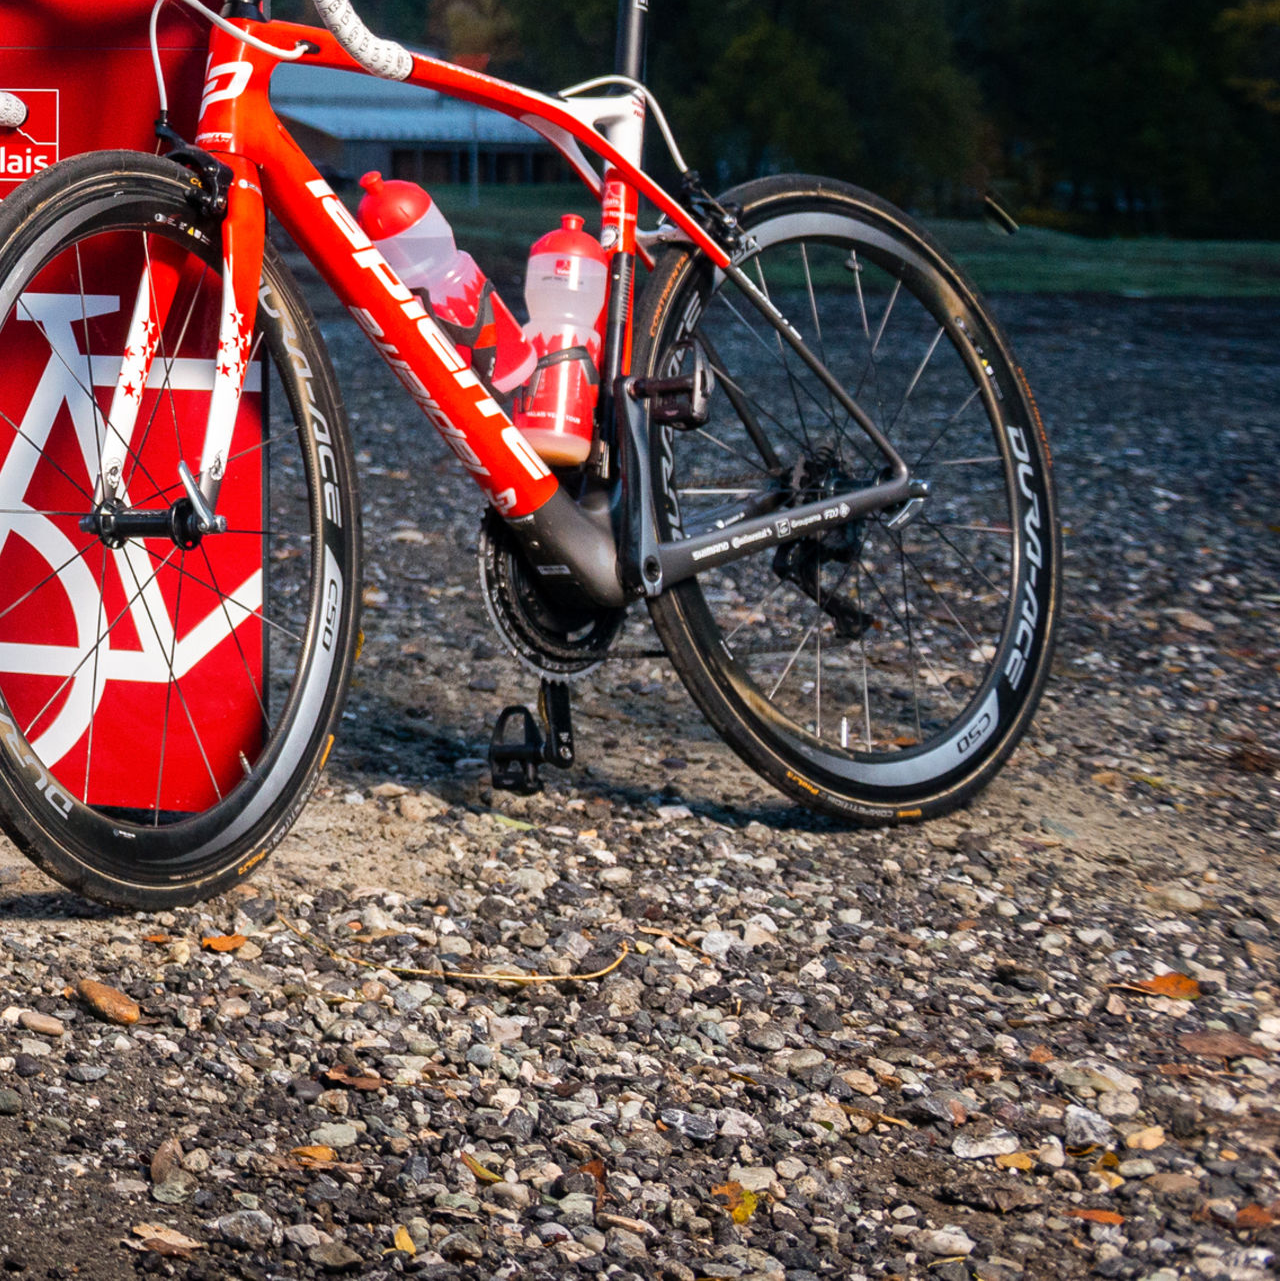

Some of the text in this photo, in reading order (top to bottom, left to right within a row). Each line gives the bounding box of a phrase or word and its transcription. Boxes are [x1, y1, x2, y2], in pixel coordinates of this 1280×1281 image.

[258, 275, 343, 529] URA-ACE
[322, 578, 339, 655] C50
[1006, 424, 1043, 692] DURA-ACE
[957, 712, 992, 755] C50
